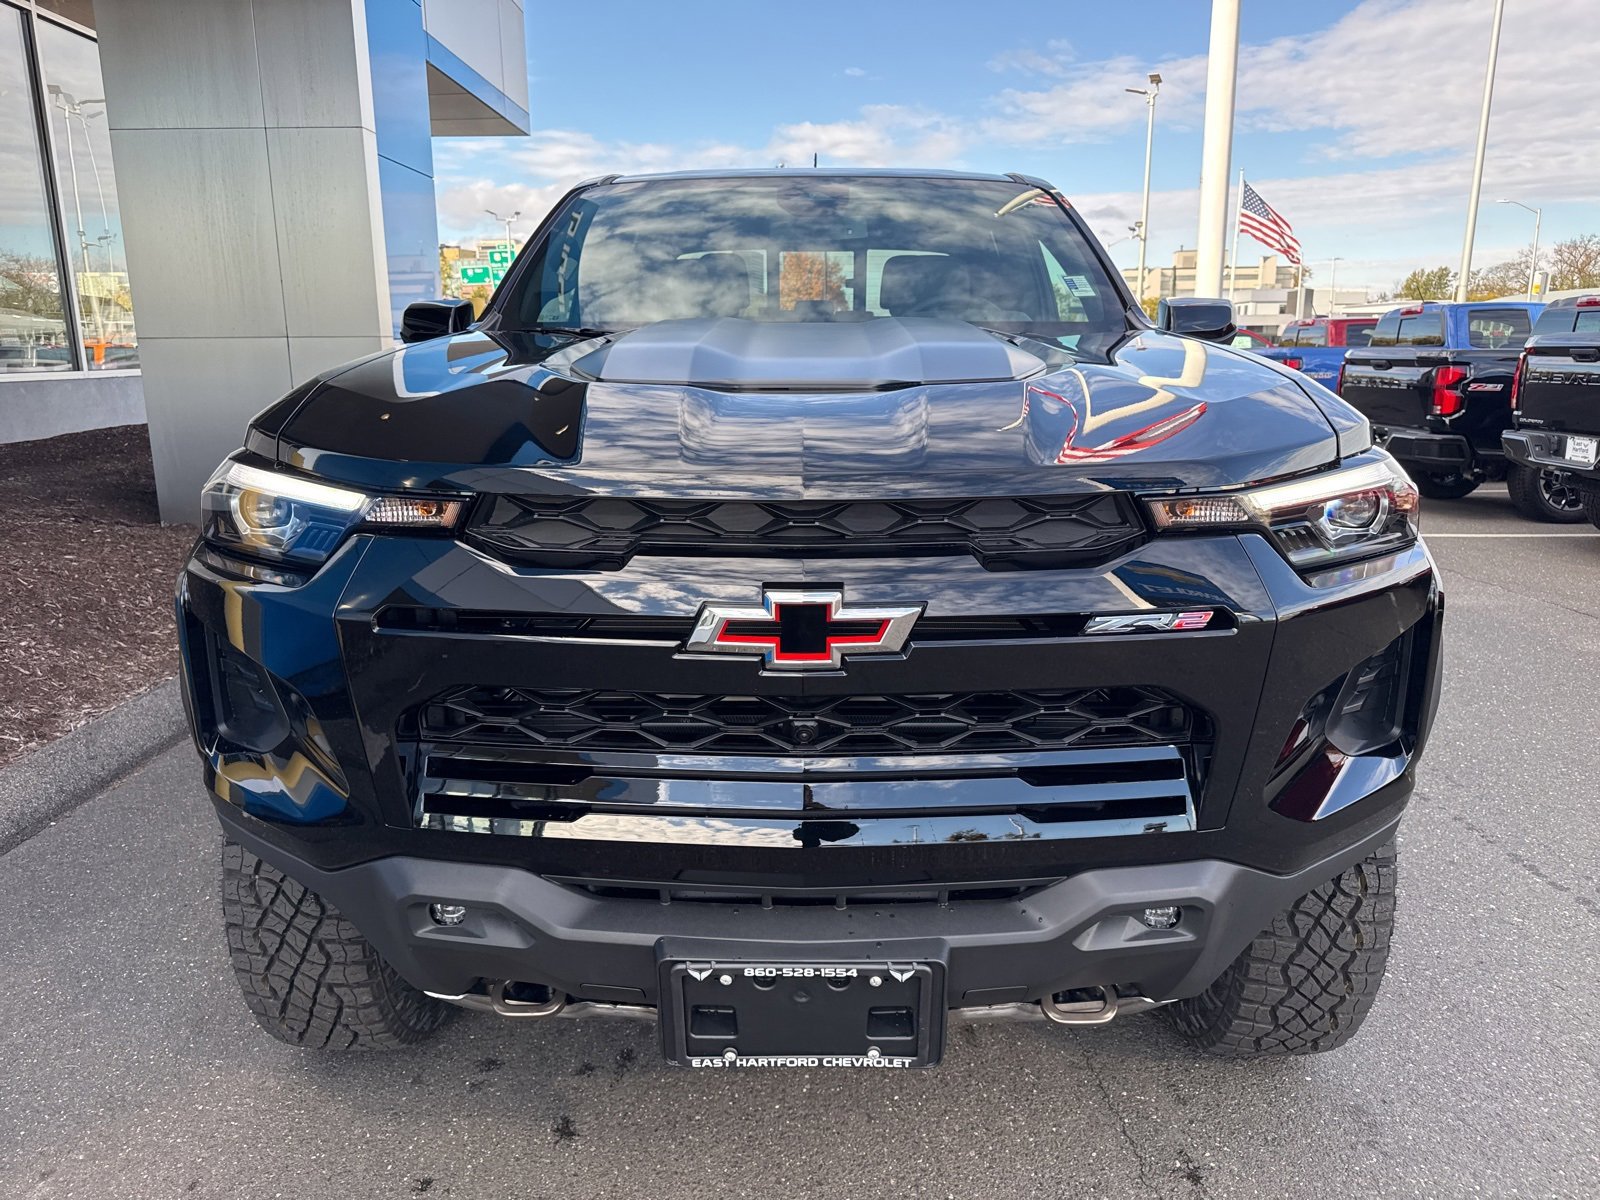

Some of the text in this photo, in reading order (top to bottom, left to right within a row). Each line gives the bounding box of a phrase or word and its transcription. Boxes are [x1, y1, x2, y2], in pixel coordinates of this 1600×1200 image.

[1085, 611, 1214, 634] ZR2
[743, 968, 858, 978] 860-528-1554
[691, 1058, 912, 1068] EAST HARTFORD CHEVROLET
